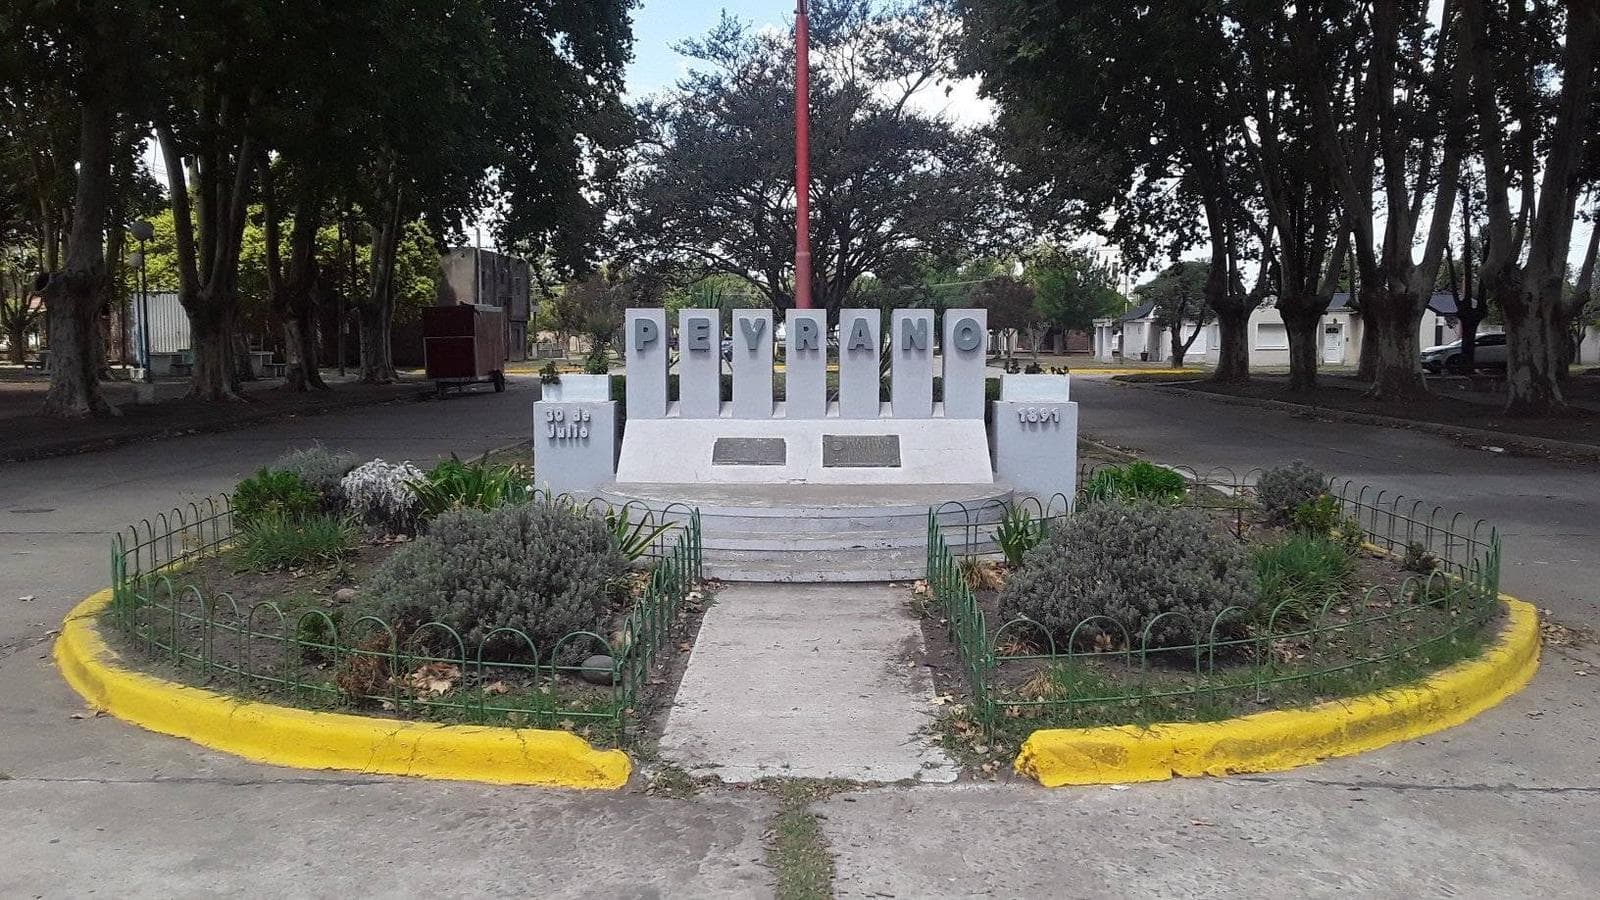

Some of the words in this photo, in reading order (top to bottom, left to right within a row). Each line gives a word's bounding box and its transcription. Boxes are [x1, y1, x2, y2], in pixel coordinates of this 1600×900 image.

[634, 318, 982, 352] PEYRANO
[546, 406, 565, 423] 30
[572, 406, 591, 423] de
[1018, 406, 1061, 424] 1891
[547, 423, 589, 440] Julio
